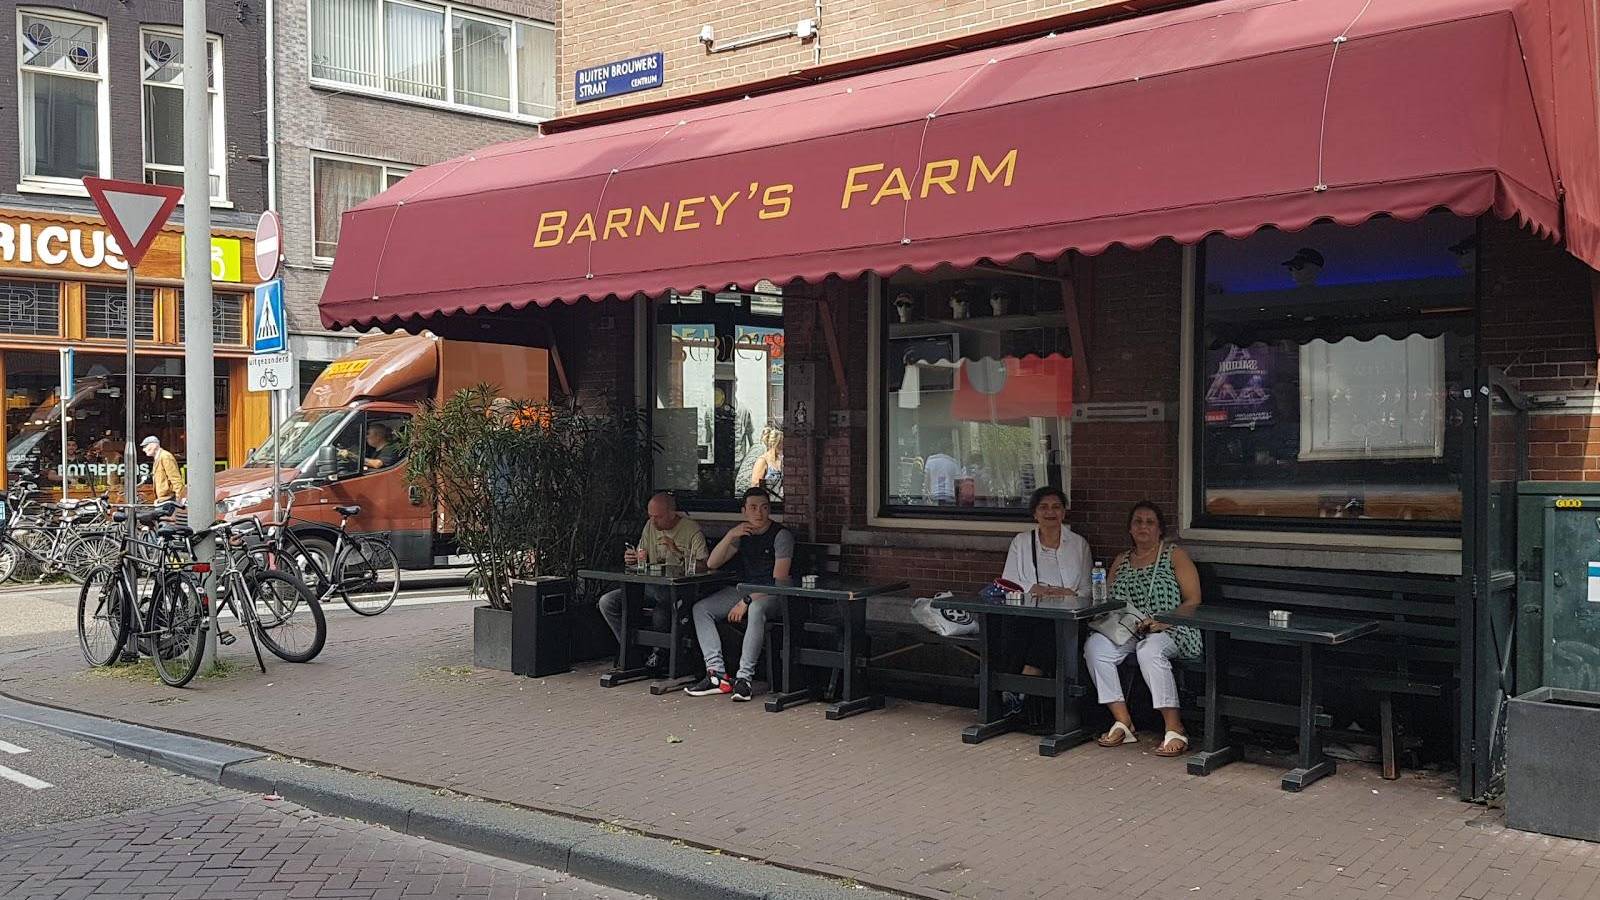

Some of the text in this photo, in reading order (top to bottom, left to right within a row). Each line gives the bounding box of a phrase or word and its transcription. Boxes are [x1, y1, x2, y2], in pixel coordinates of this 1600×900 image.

[579, 56, 657, 84] BUITEN BROUWERS
[579, 81, 607, 97] STRAAT
[630, 75, 657, 88] CENTRUM
[533, 149, 1017, 248] BARNEY'S FARM
